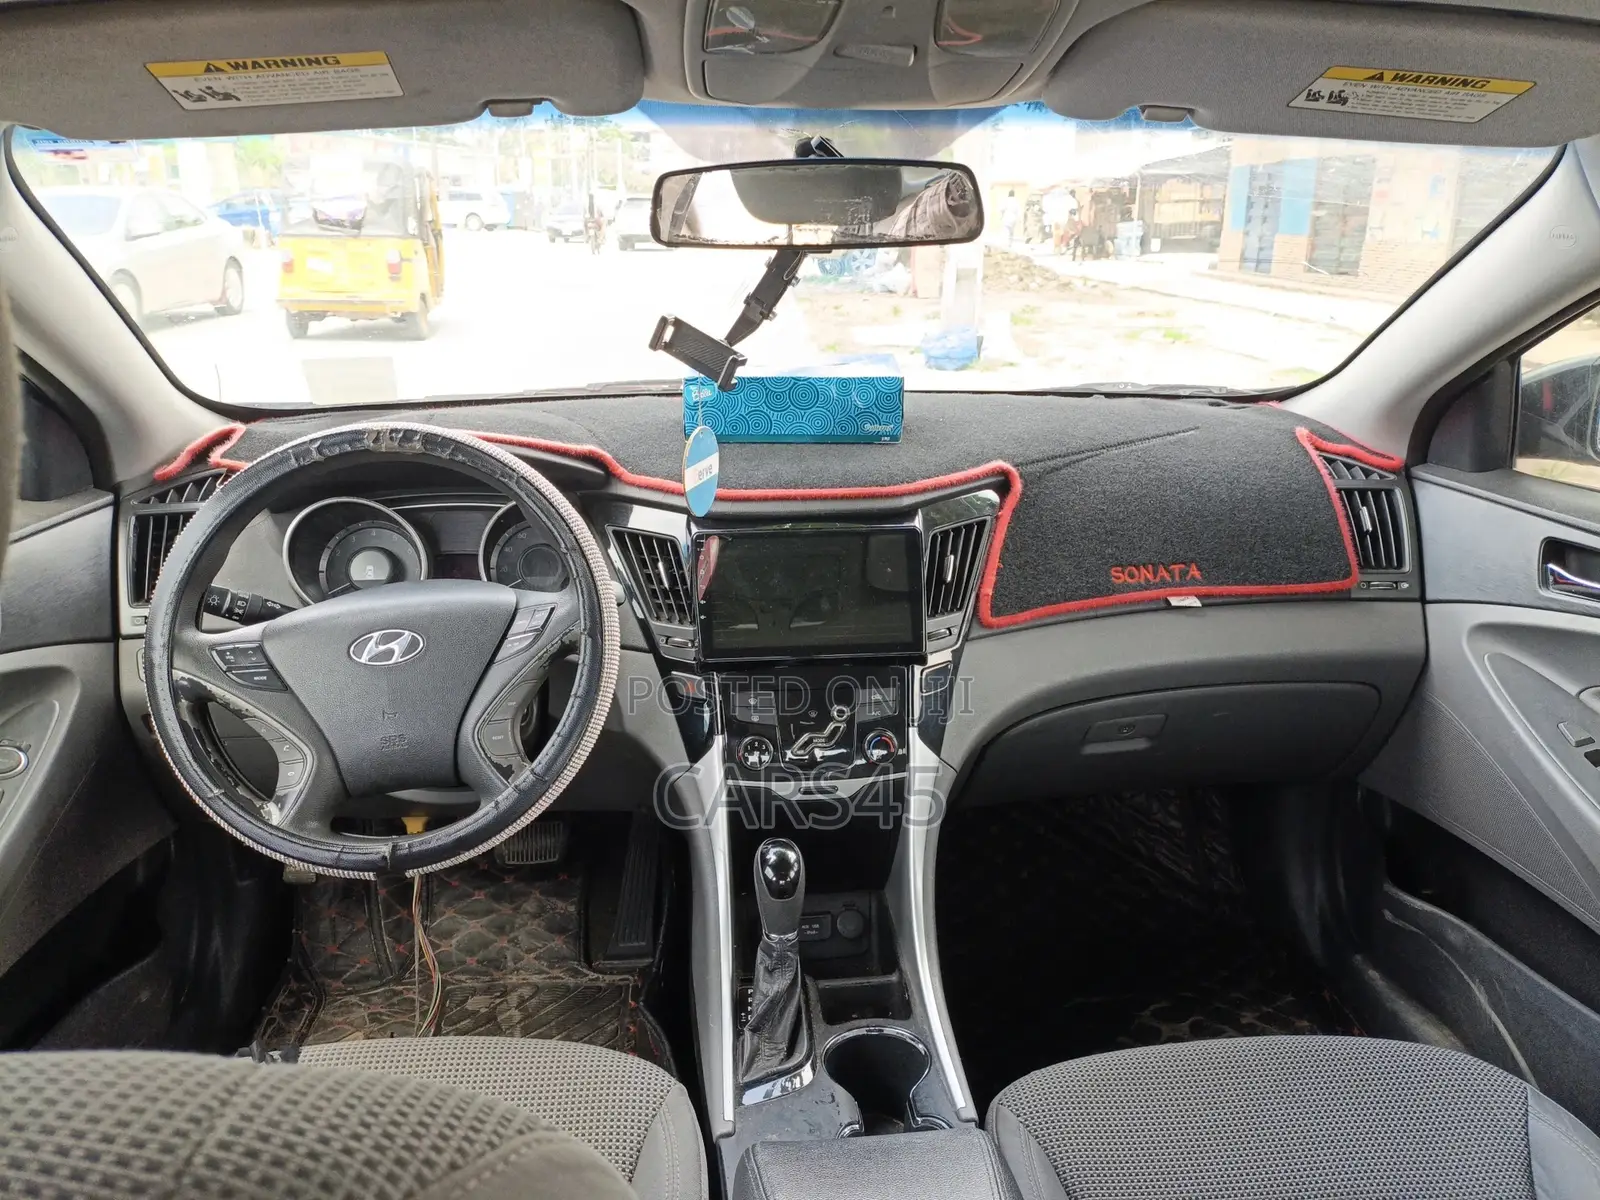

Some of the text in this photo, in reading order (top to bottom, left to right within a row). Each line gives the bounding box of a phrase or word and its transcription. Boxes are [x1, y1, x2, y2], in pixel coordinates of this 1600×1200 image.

[226, 55, 341, 72] WARNING
[1342, 81, 1366, 89] EVEN
[1395, 86, 1442, 95] ADVANCED
[1390, 73, 1490, 89] WARNING
[1111, 563, 1203, 584] SONATA
